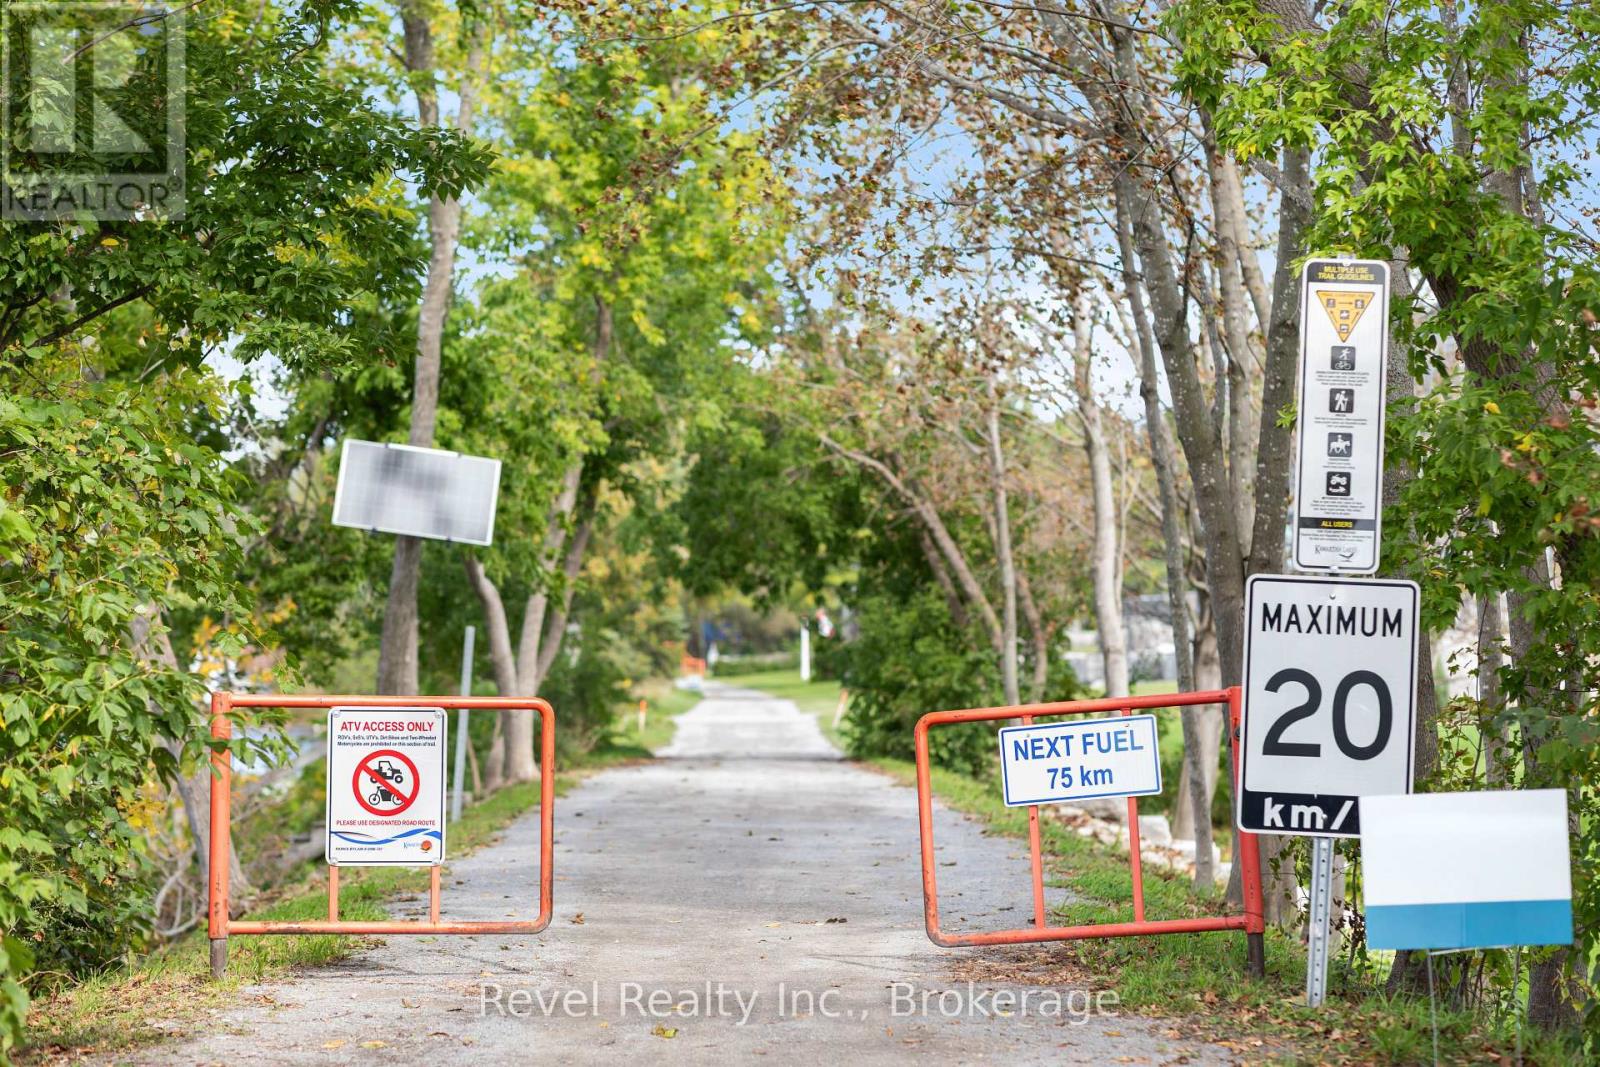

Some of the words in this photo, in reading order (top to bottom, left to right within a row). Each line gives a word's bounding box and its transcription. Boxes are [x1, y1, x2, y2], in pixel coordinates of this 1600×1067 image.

[1318, 271, 1336, 280] TRAIL
[1337, 273, 1375, 281] GUIDELINES
[1320, 520, 1332, 528] ALL
[1261, 602, 1403, 638] MAXIMUM
[340, 721, 361, 732] ATV
[363, 721, 405, 732] ACCESS
[407, 721, 434, 732] ONLY
[1261, 667, 1393, 761] 20
[1013, 735, 1074, 761] NEXT
[1082, 729, 1144, 755] FUEL
[1047, 767, 1073, 789] 75
[1080, 765, 1113, 786] km
[1263, 797, 1355, 831] km/
